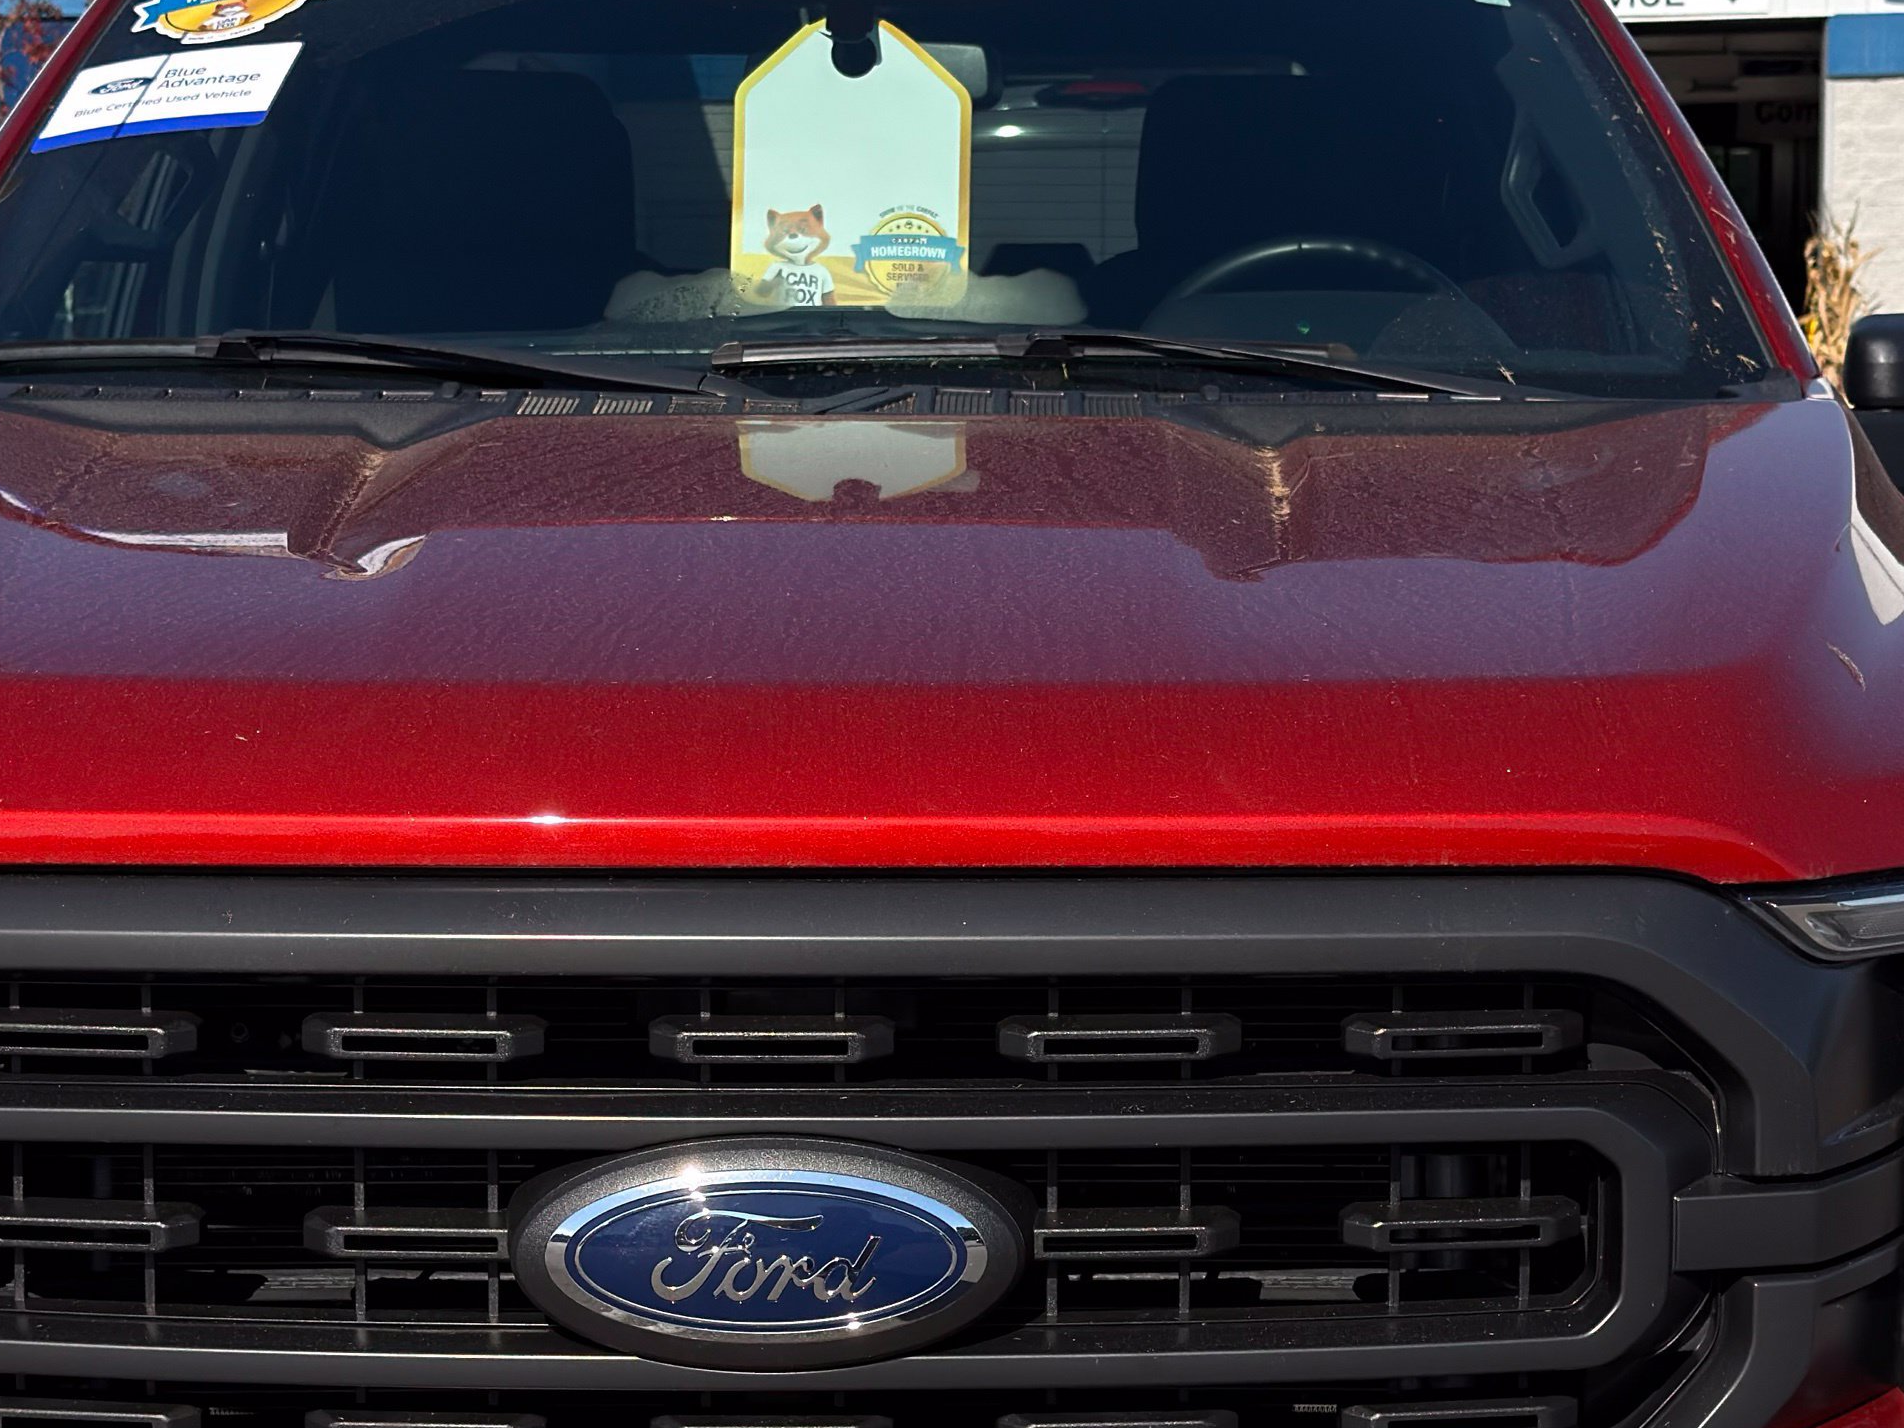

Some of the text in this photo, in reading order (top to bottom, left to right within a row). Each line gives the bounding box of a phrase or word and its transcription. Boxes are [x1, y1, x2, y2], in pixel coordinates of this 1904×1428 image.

[157, 73, 261, 89] Advantage
[164, 66, 207, 79] Blue
[74, 106, 103, 118] Blue
[166, 93, 200, 104] Used
[205, 89, 252, 100] Vehicle
[870, 245, 947, 259] HOMEGROWN
[891, 263, 915, 272] SOLD
[786, 272, 819, 290] CAR
[785, 288, 817, 306] FOX
[650, 1208, 881, 1304] Ford
